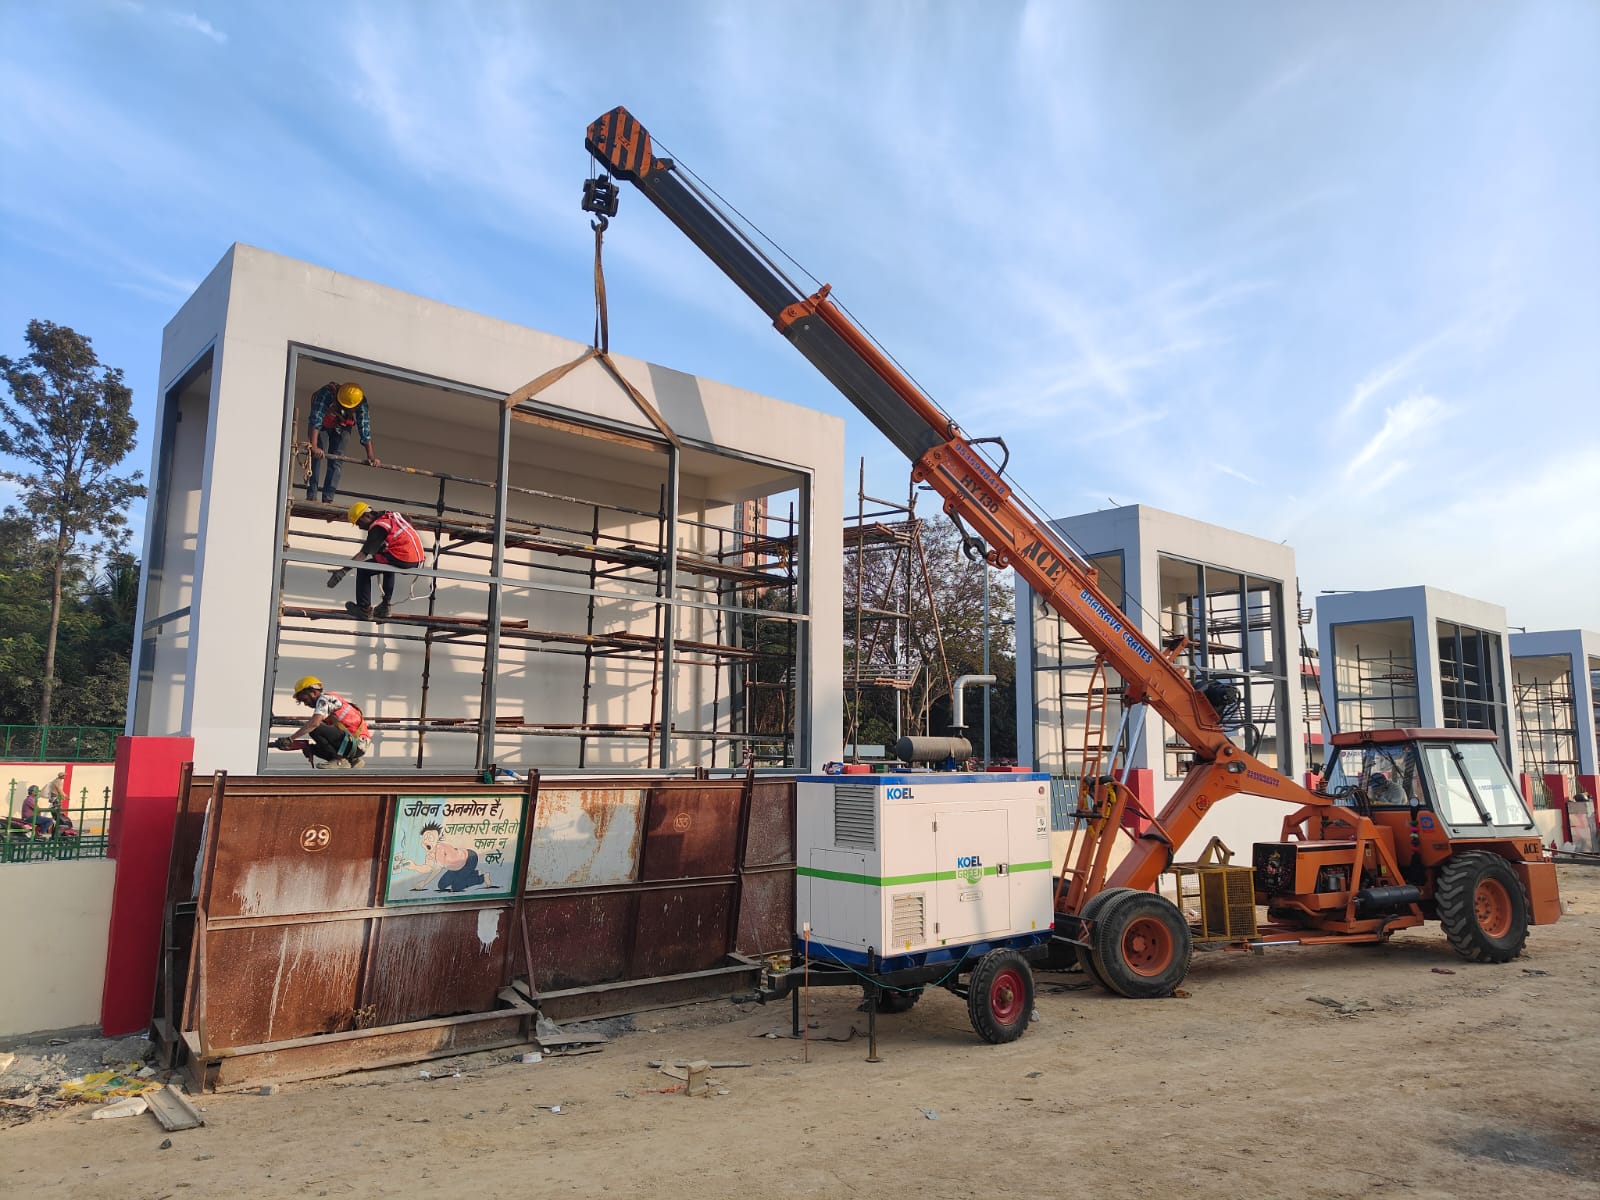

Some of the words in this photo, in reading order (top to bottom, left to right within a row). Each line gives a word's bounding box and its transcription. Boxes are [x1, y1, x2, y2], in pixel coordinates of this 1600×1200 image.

[962, 474, 981, 492] HY
[980, 492, 999, 514] 130
[1022, 540, 1068, 583] ACE
[1080, 589, 1122, 633] BHAIRAVA
[1122, 630, 1153, 664] CRANES
[886, 787, 915, 801] KOEL
[404, 800, 442, 817] जीवन
[442, 799, 488, 817] अनमोल
[444, 818, 490, 836] जानकारी
[303, 829, 330, 847] 29
[474, 838, 498, 849] काम
[498, 837, 509, 848] न
[1524, 843, 1539, 855] ACE
[957, 855, 982, 868] KOEL
